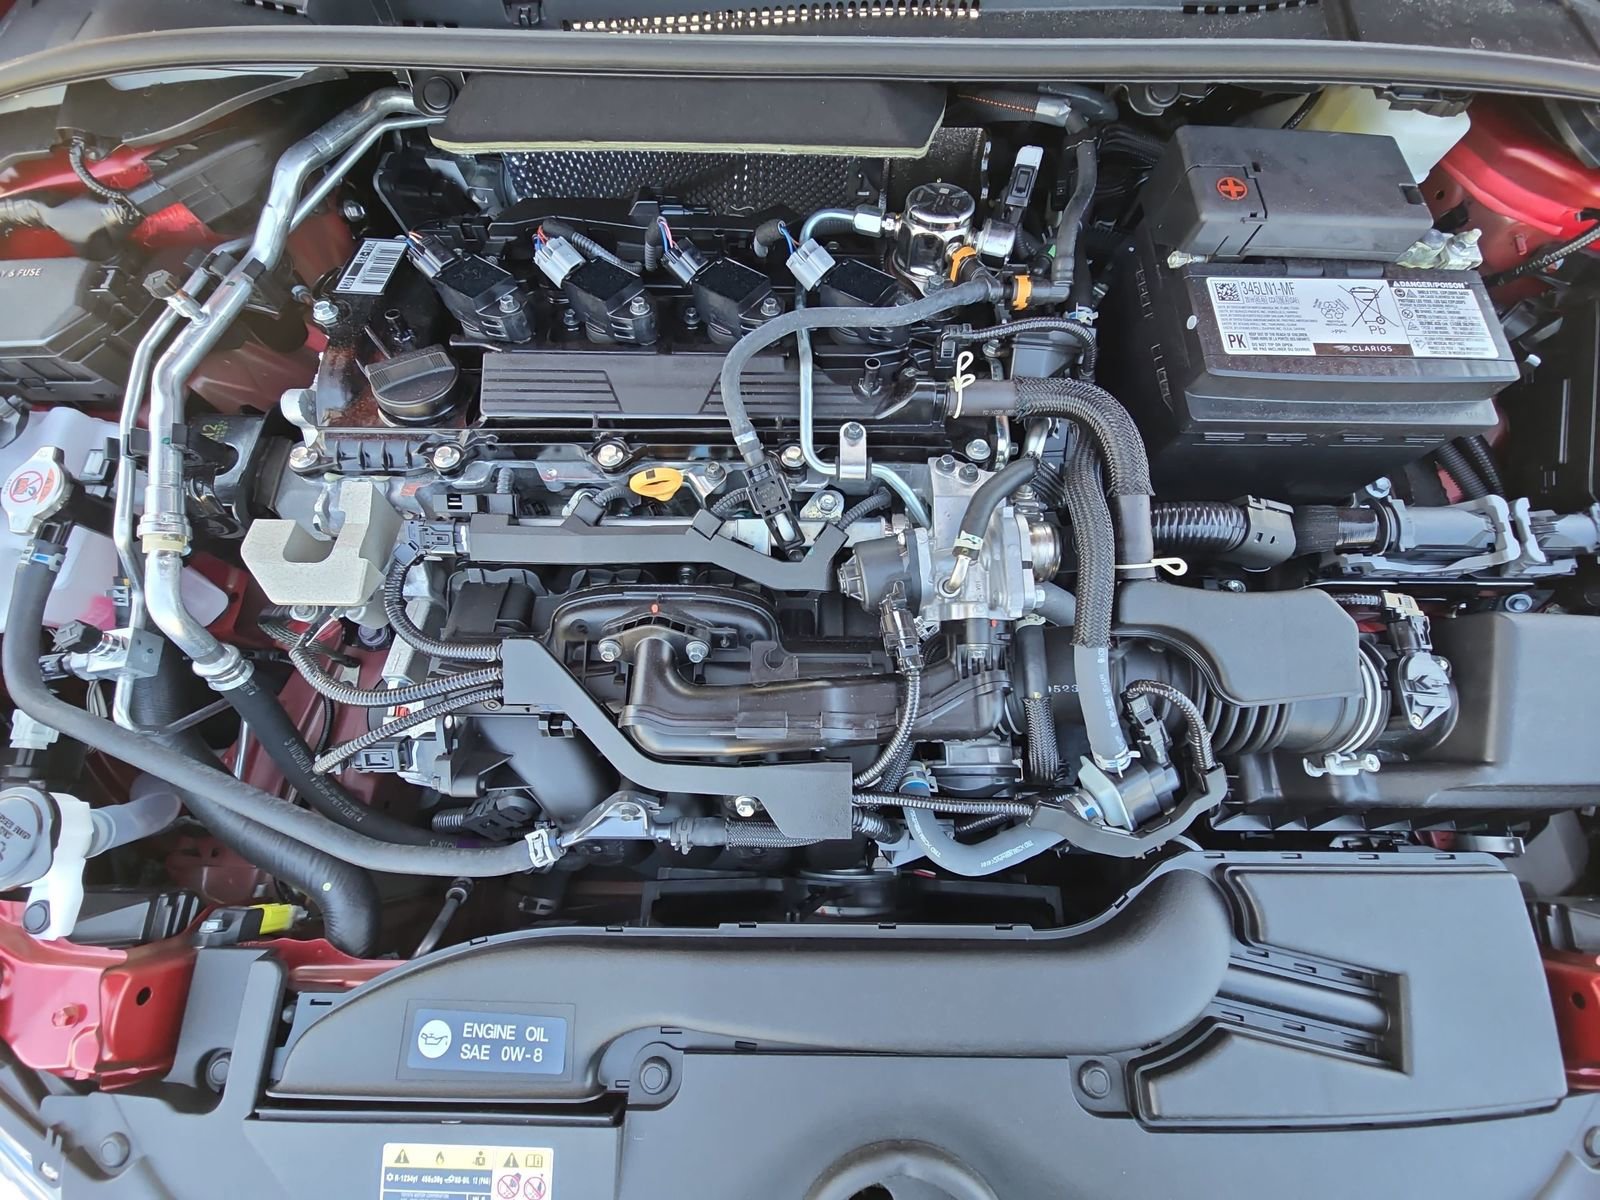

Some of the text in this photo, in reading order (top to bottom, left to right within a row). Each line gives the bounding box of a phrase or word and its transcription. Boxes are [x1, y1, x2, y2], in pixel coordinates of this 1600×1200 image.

[16, 267, 42, 277] FUSE
[1240, 281, 1296, 296] 345LN1-MF
[1370, 325, 1386, 335] Pb
[1228, 334, 1247, 348] PK
[462, 1022, 549, 1042] ENGINE OIL
[460, 1044, 543, 1063] SAE 0W-8
